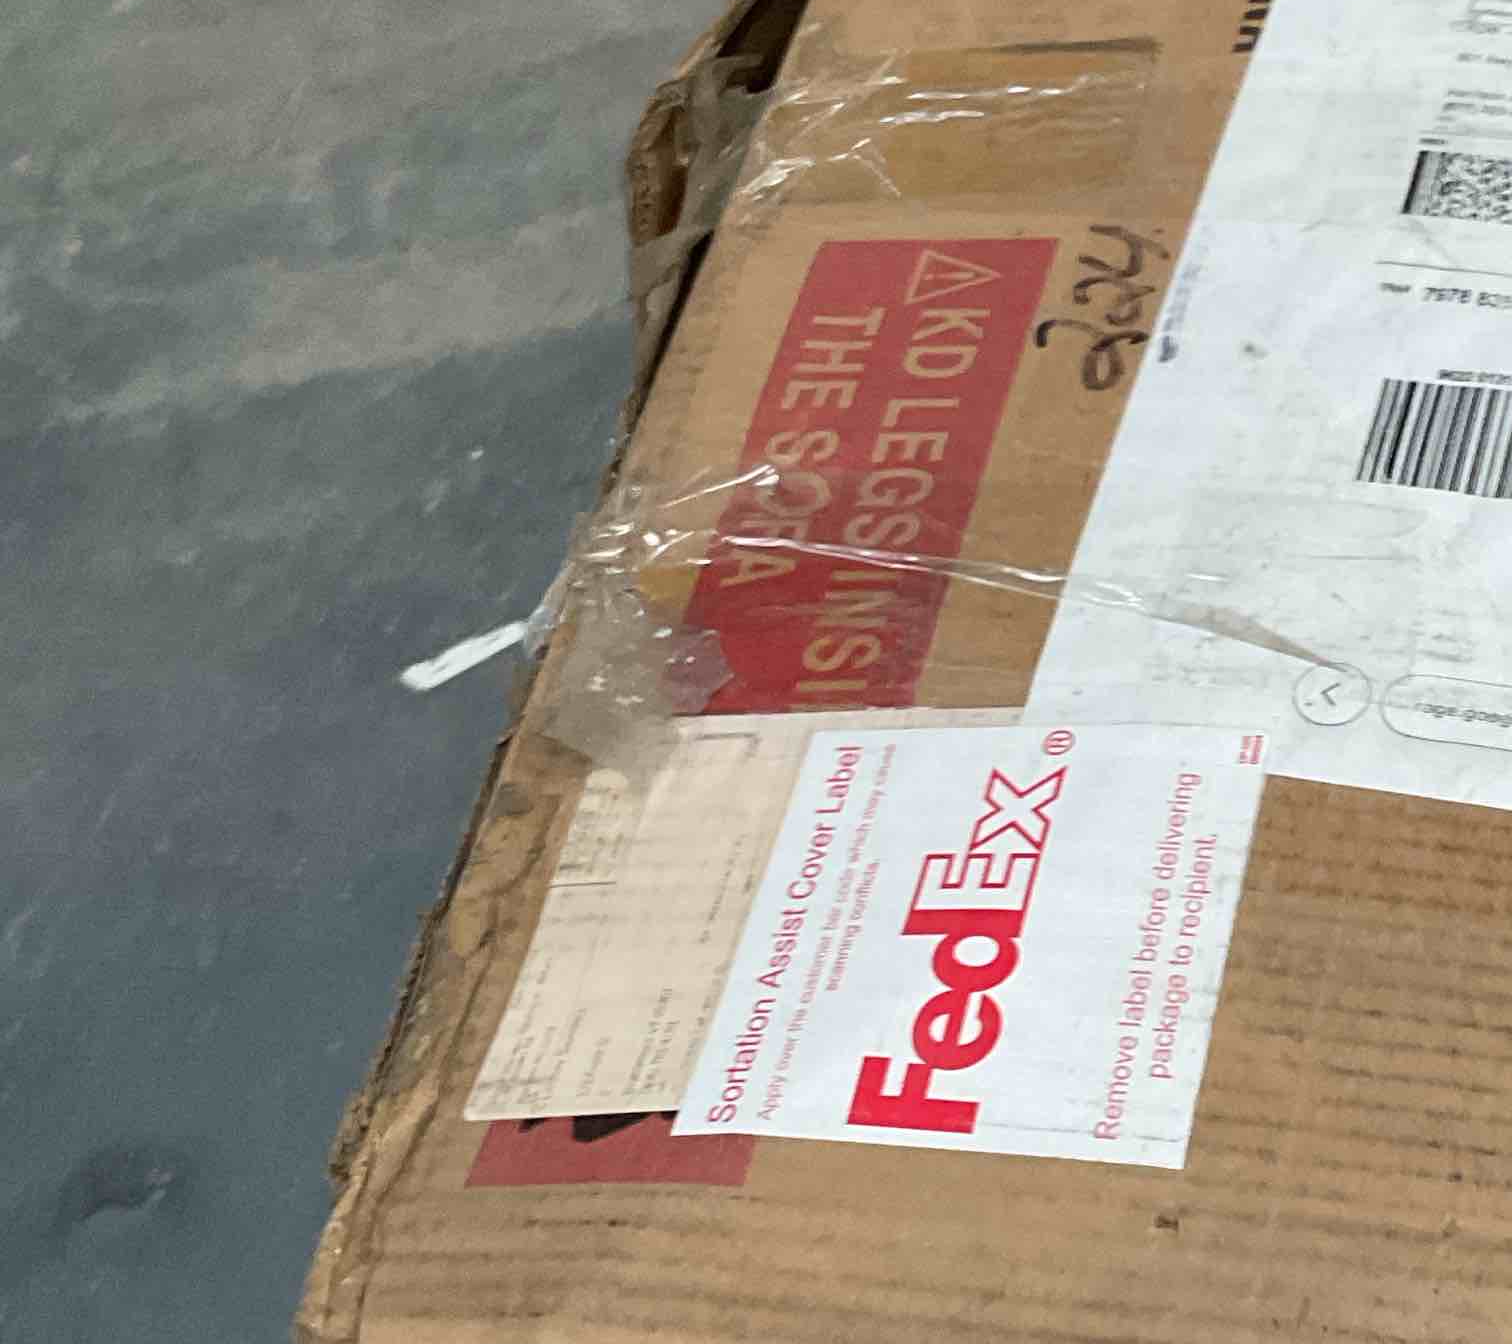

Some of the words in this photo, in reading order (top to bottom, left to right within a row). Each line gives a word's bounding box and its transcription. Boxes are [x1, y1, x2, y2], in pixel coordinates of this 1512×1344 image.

[783, 306, 886, 410] THE
[901, 308, 992, 380] KD
[719, 429, 840, 587] SOFA
[843, 396, 961, 548] LEGS
[791, 566, 899, 710] INSI
[1152, 771, 1202, 881] delivering
[707, 997, 777, 1124] Sortation
[758, 905, 808, 989] Assist
[787, 822, 835, 900] Cover
[817, 745, 864, 815] Label
[1130, 887, 1170, 962] before
[1176, 833, 1218, 938] recipient.
[847, 766, 1068, 1134] FedEx
[1119, 969, 1153, 1028] label
[1169, 943, 1195, 966] to
[1147, 973, 1188, 1080] package
[757, 1074, 788, 1121] Apply
[1093, 1035, 1139, 1142] Remove
